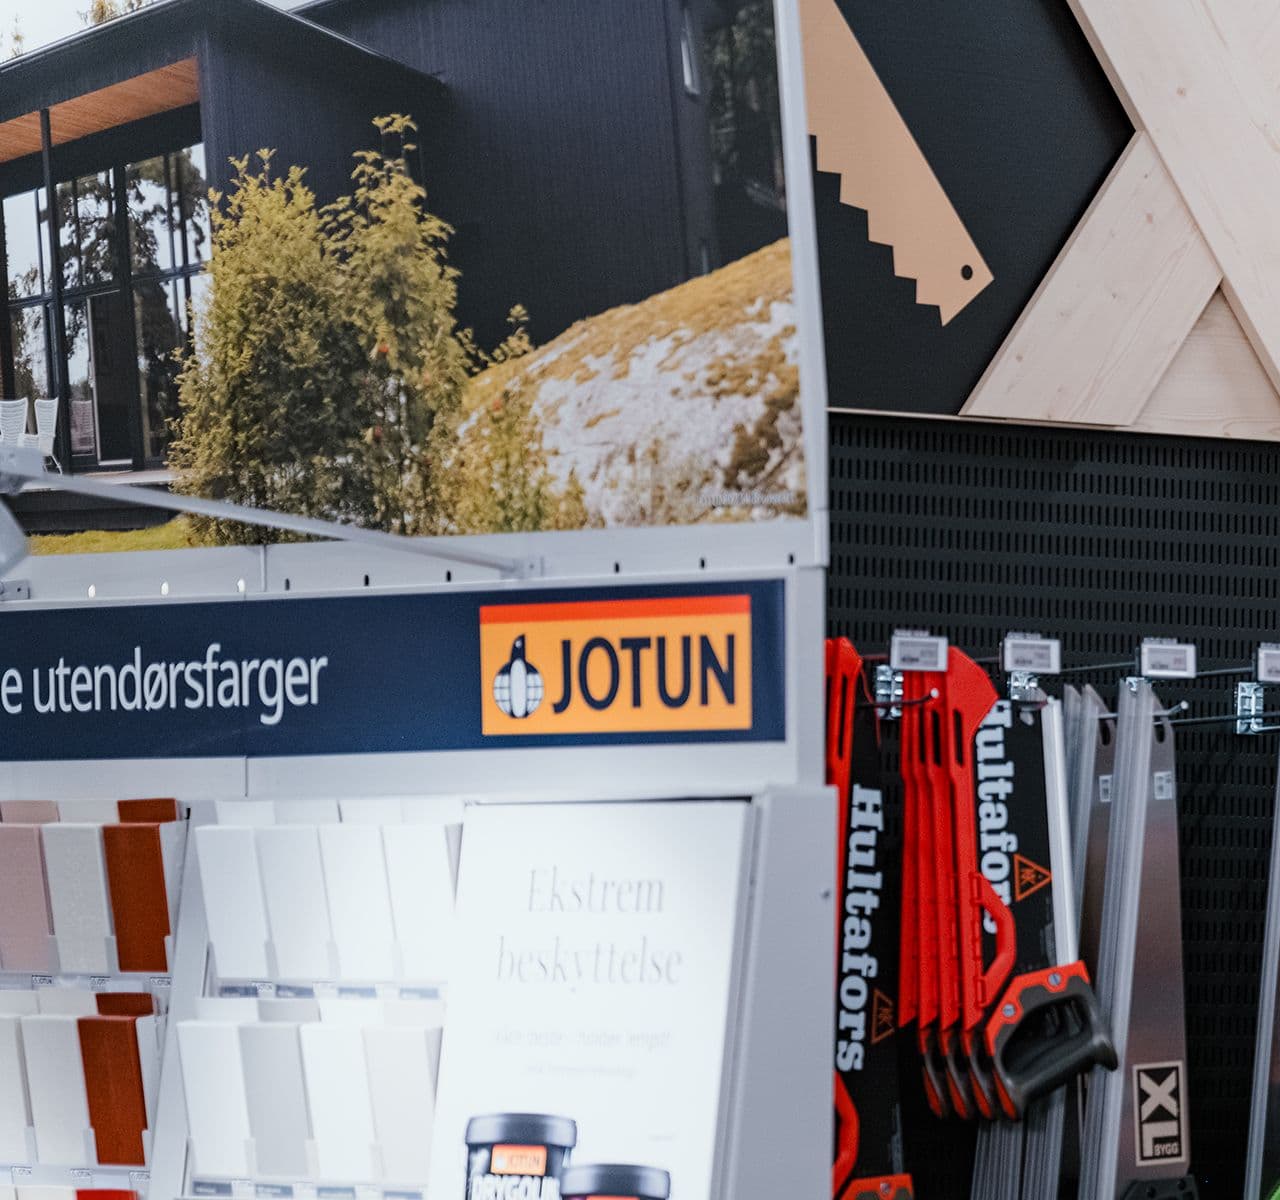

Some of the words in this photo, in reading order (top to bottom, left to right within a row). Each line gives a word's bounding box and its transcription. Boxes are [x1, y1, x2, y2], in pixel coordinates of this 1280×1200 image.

[33, 642, 328, 726] utendørsfarger
[553, 633, 737, 714] JOTUN
[528, 865, 665, 913] Ekstrem
[836, 784, 884, 1072] Hultafors
[497, 935, 684, 993] beskyttelse
[1154, 1142, 1179, 1156] BYGG
